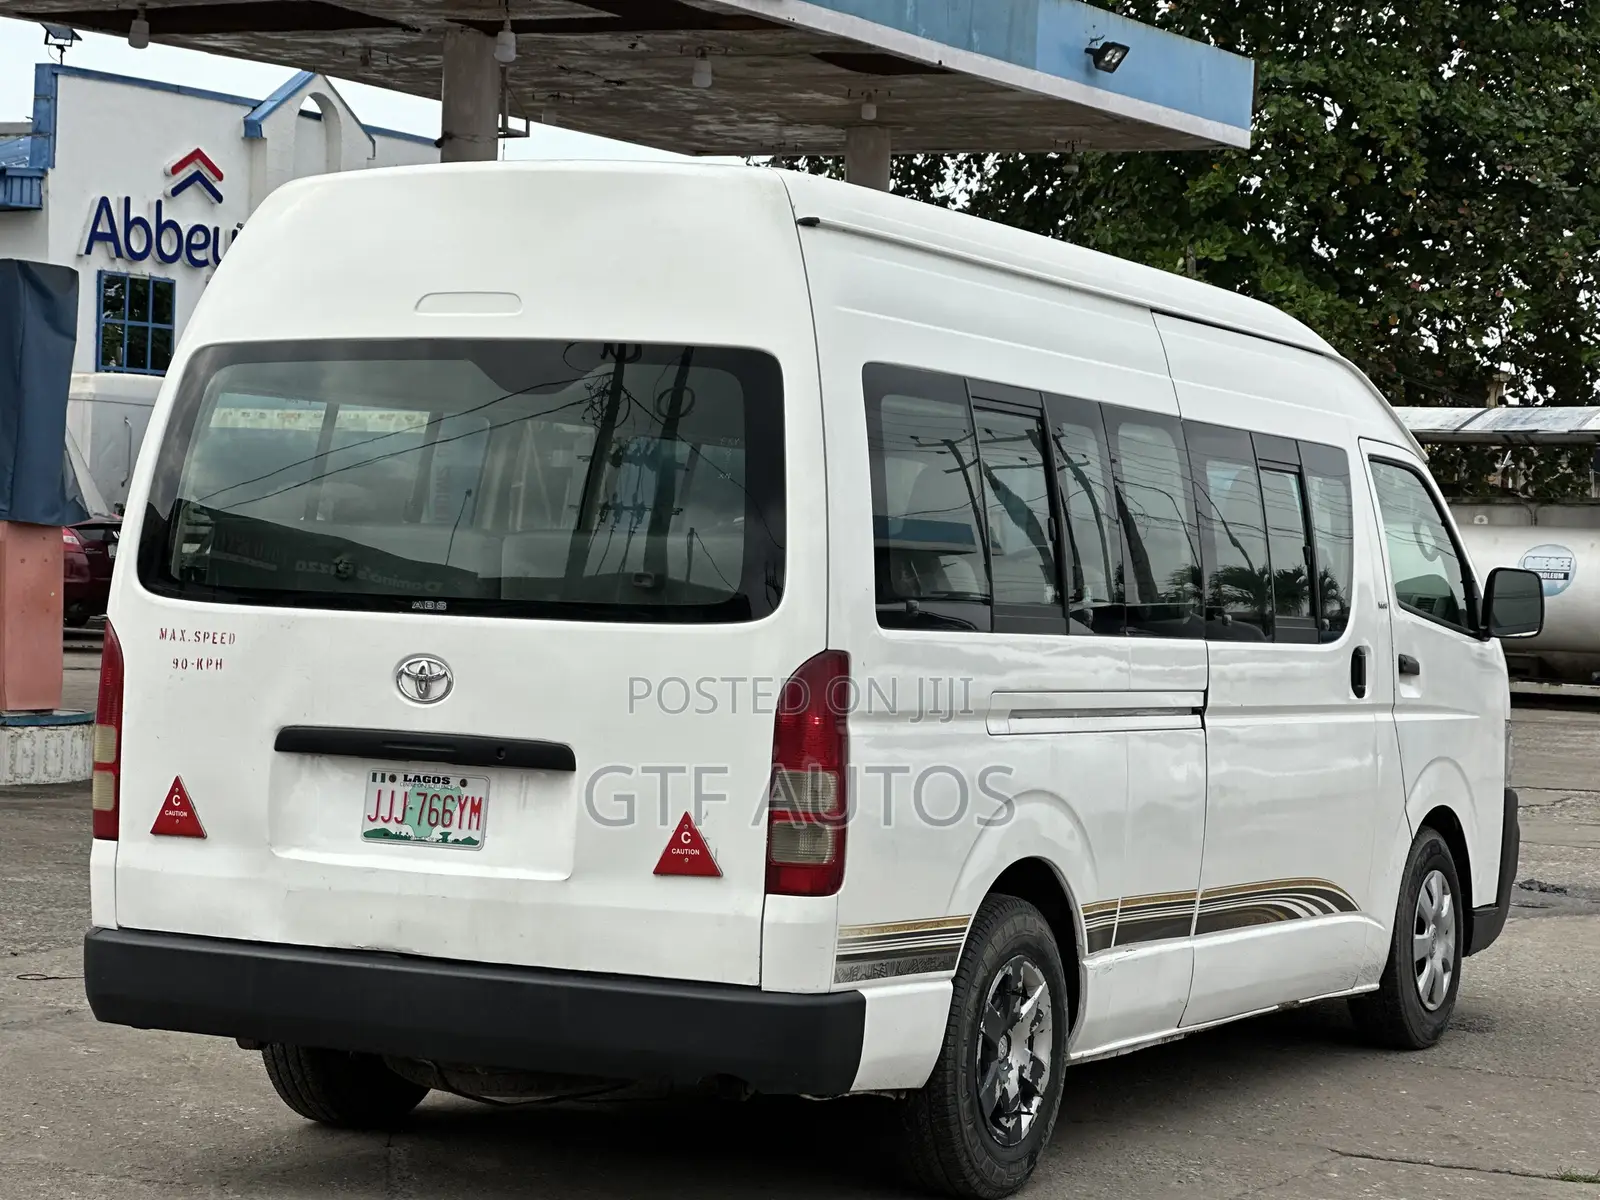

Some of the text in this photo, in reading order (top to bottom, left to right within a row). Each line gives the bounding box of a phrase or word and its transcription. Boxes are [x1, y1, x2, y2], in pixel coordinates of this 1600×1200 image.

[412, 601, 447, 610] ABS
[403, 774, 451, 785] LAGOS
[172, 794, 181, 806] C
[681, 831, 691, 844] C
